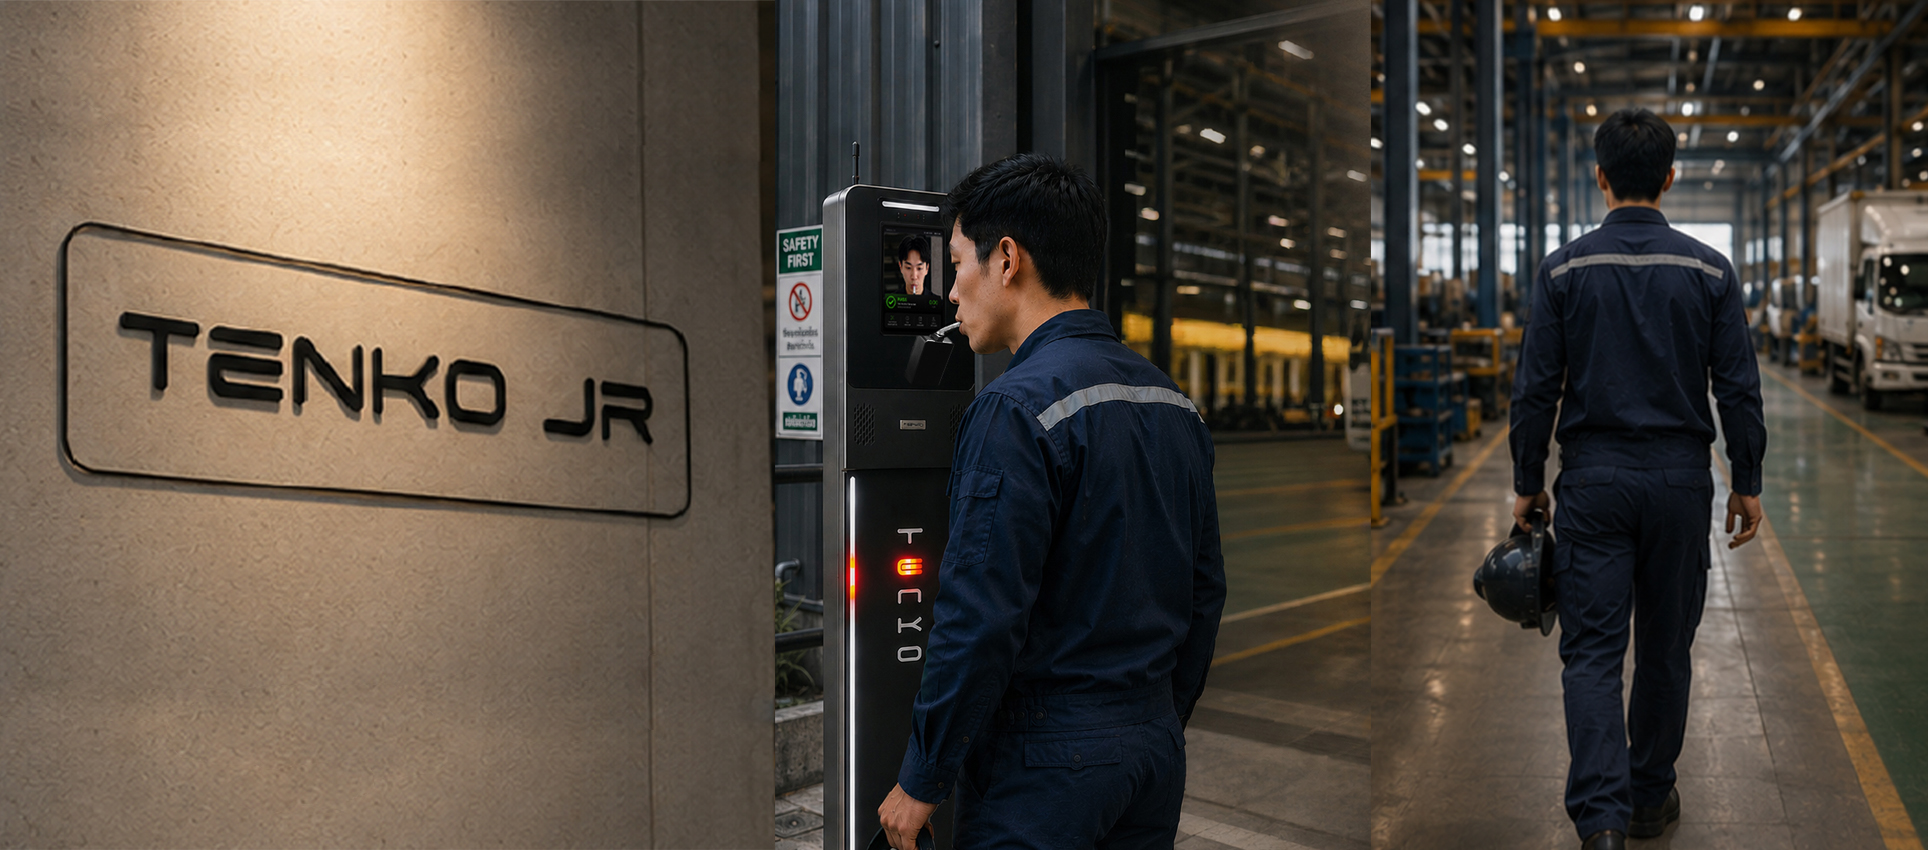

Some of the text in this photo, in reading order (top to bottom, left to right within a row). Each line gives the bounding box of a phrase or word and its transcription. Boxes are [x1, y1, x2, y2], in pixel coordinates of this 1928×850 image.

[783, 235, 819, 252] SAFETY
[787, 252, 814, 268] FIRST
[119, 311, 654, 445] TENKO JR
